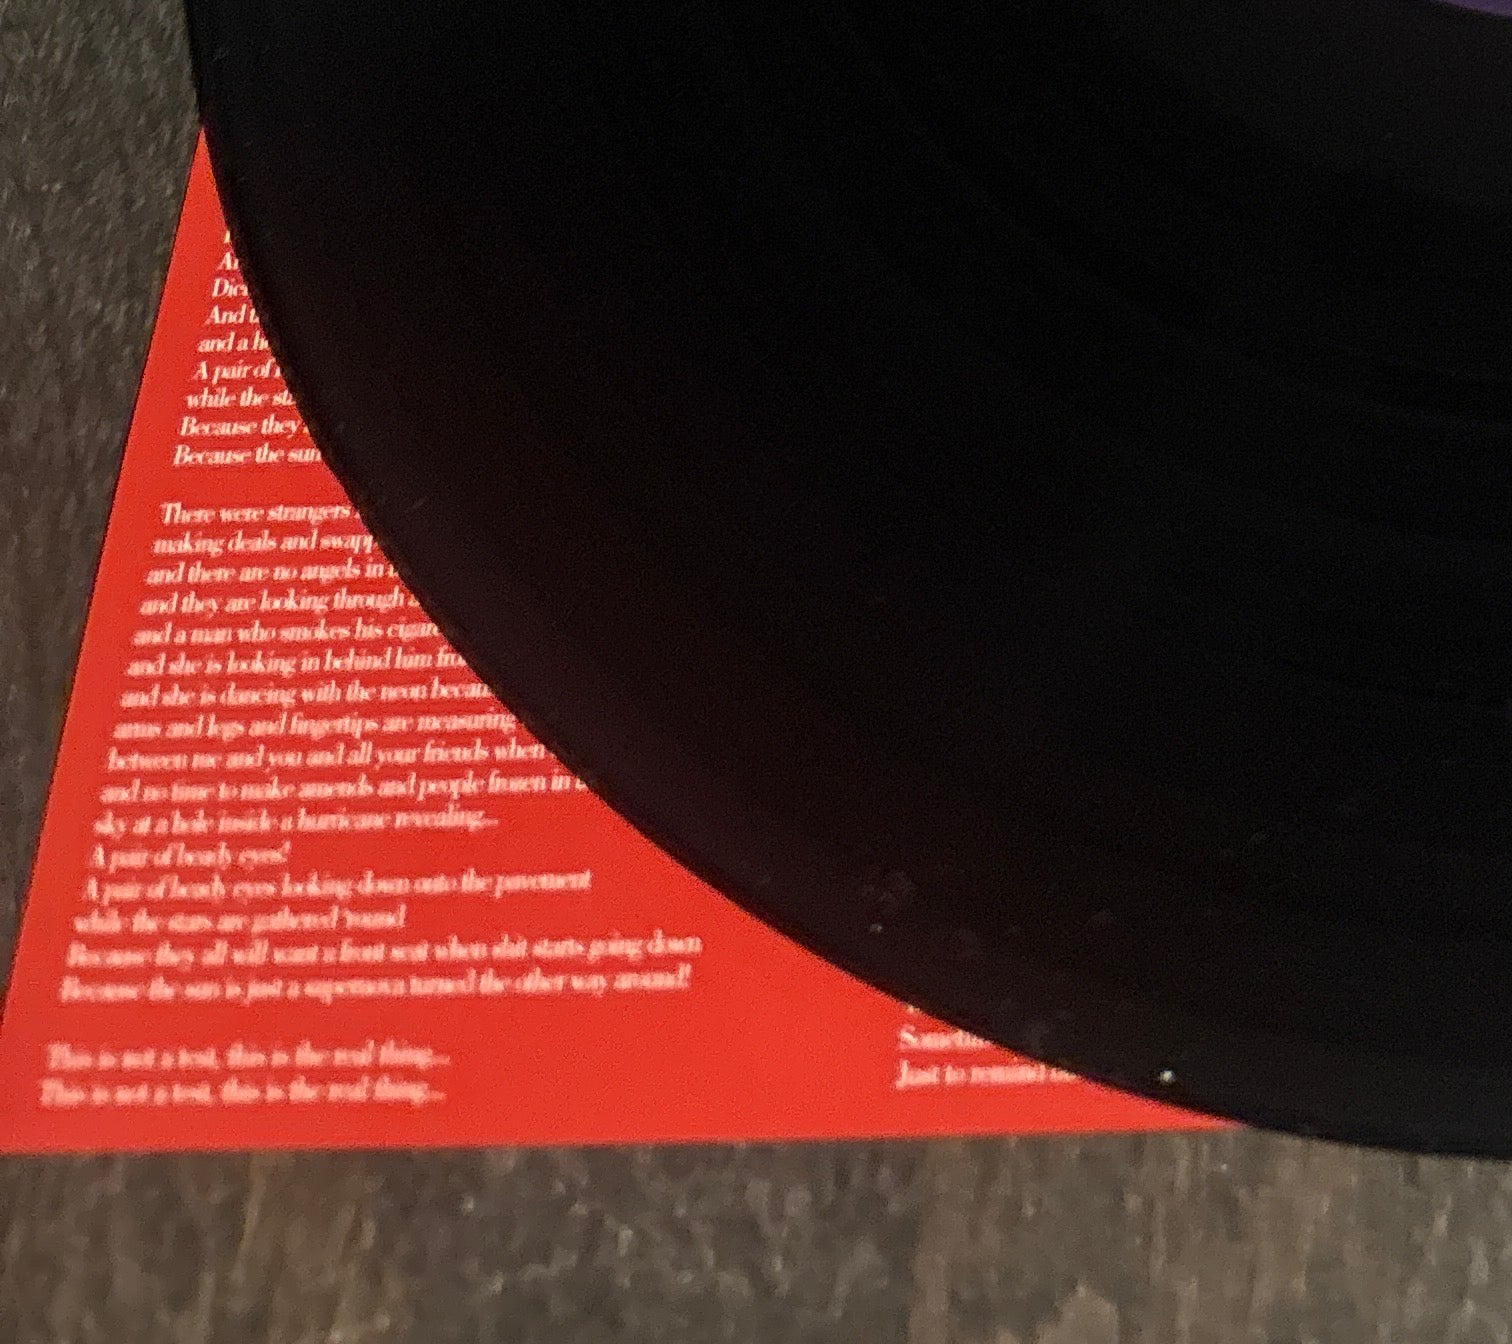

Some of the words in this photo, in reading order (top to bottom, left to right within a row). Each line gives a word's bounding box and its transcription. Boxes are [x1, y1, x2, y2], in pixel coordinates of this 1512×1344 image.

[204, 304, 247, 325] And
[197, 331, 236, 353] and
[237, 338, 248, 351] a
[192, 360, 209, 380] A
[212, 359, 252, 385] pair
[253, 357, 277, 378] of
[185, 387, 237, 409] while
[239, 387, 269, 407] the
[180, 415, 257, 436] Because
[261, 413, 299, 439] they
[172, 444, 253, 466] Because
[255, 442, 285, 463] the
[161, 502, 216, 525] There
[219, 506, 264, 523] were
[266, 504, 351, 525] strangers
[153, 531, 225, 558] making
[227, 530, 277, 551] deals
[280, 528, 318, 551] and
[147, 561, 185, 584] and
[187, 560, 236, 583] there
[139, 591, 178, 615] and
[181, 590, 218, 618] they
[259, 588, 329, 615] looking
[332, 585, 404, 615] through
[132, 621, 172, 646] and
